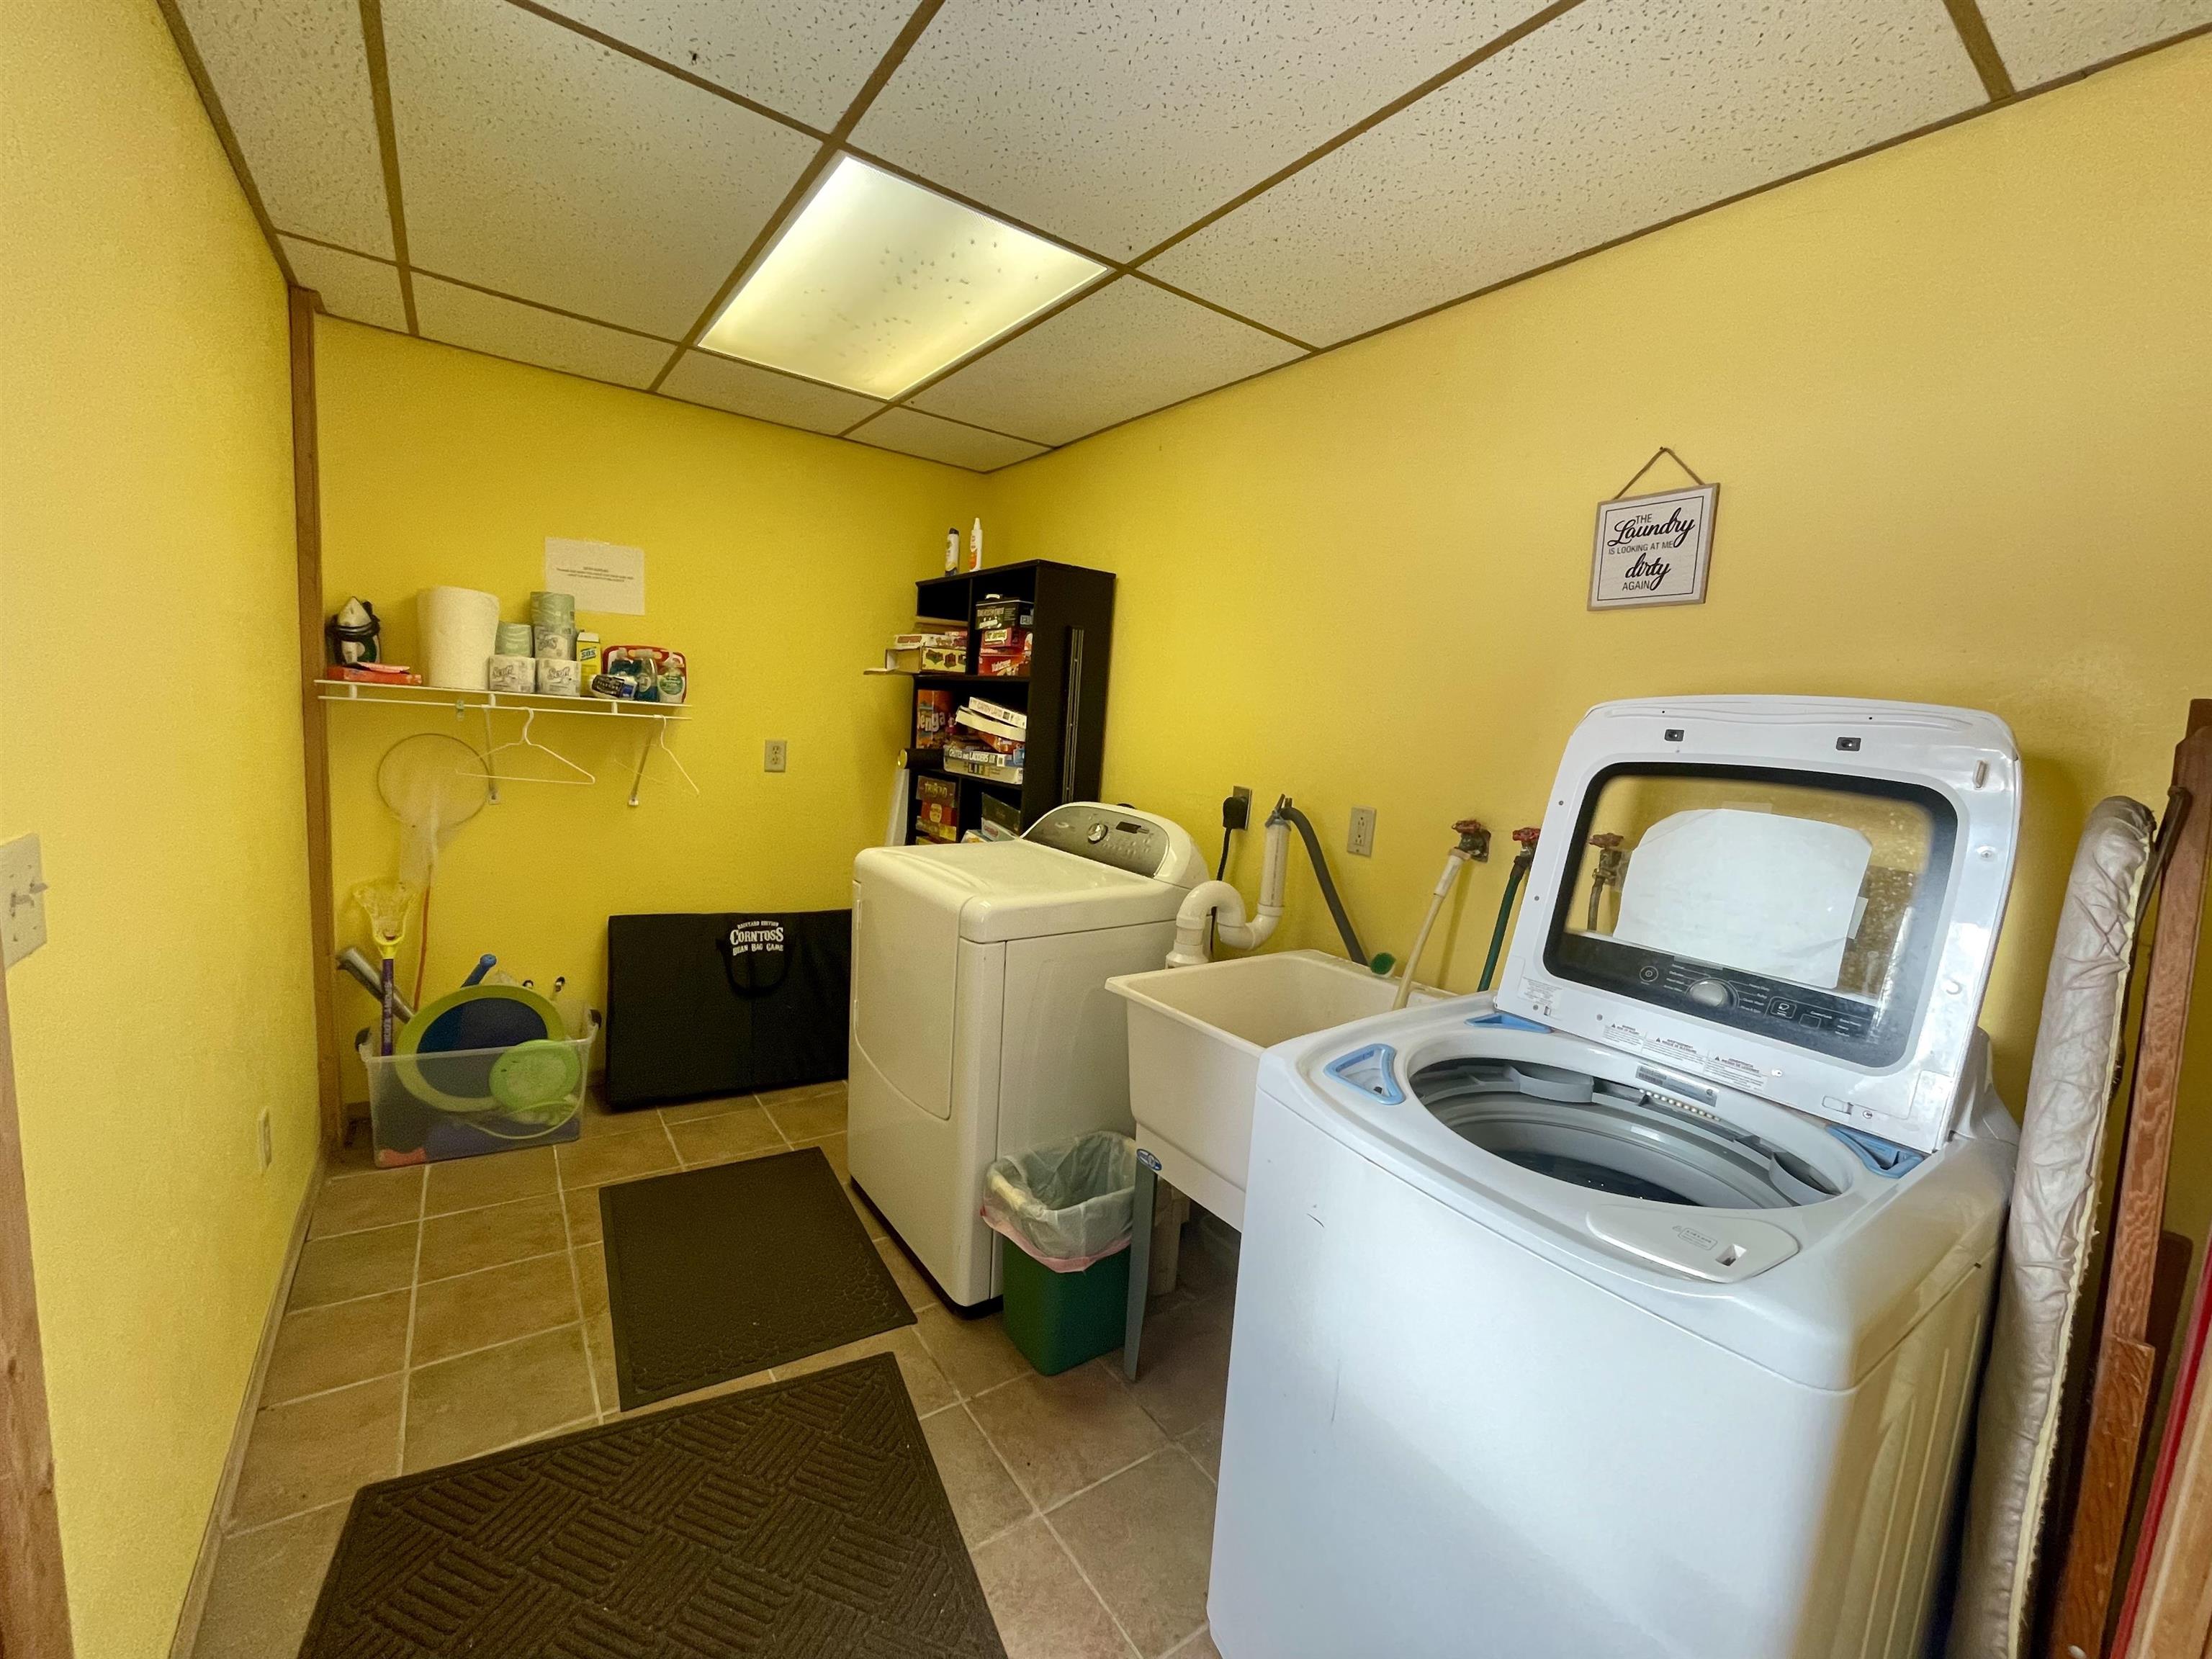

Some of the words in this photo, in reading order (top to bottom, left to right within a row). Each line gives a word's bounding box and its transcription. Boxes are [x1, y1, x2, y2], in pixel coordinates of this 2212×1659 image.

[1636, 513, 1653, 524] THE
[1607, 507, 1695, 548] Laundry
[1617, 541, 1648, 554] LOOKING
[1650, 541, 1660, 551] AT
[1662, 541, 1674, 549] ME
[1625, 552, 1671, 590] dirty
[1622, 580, 1650, 591] AGAIN
[730, 927, 784, 945] CORNTOSS
[751, 943, 763, 952] BAG
